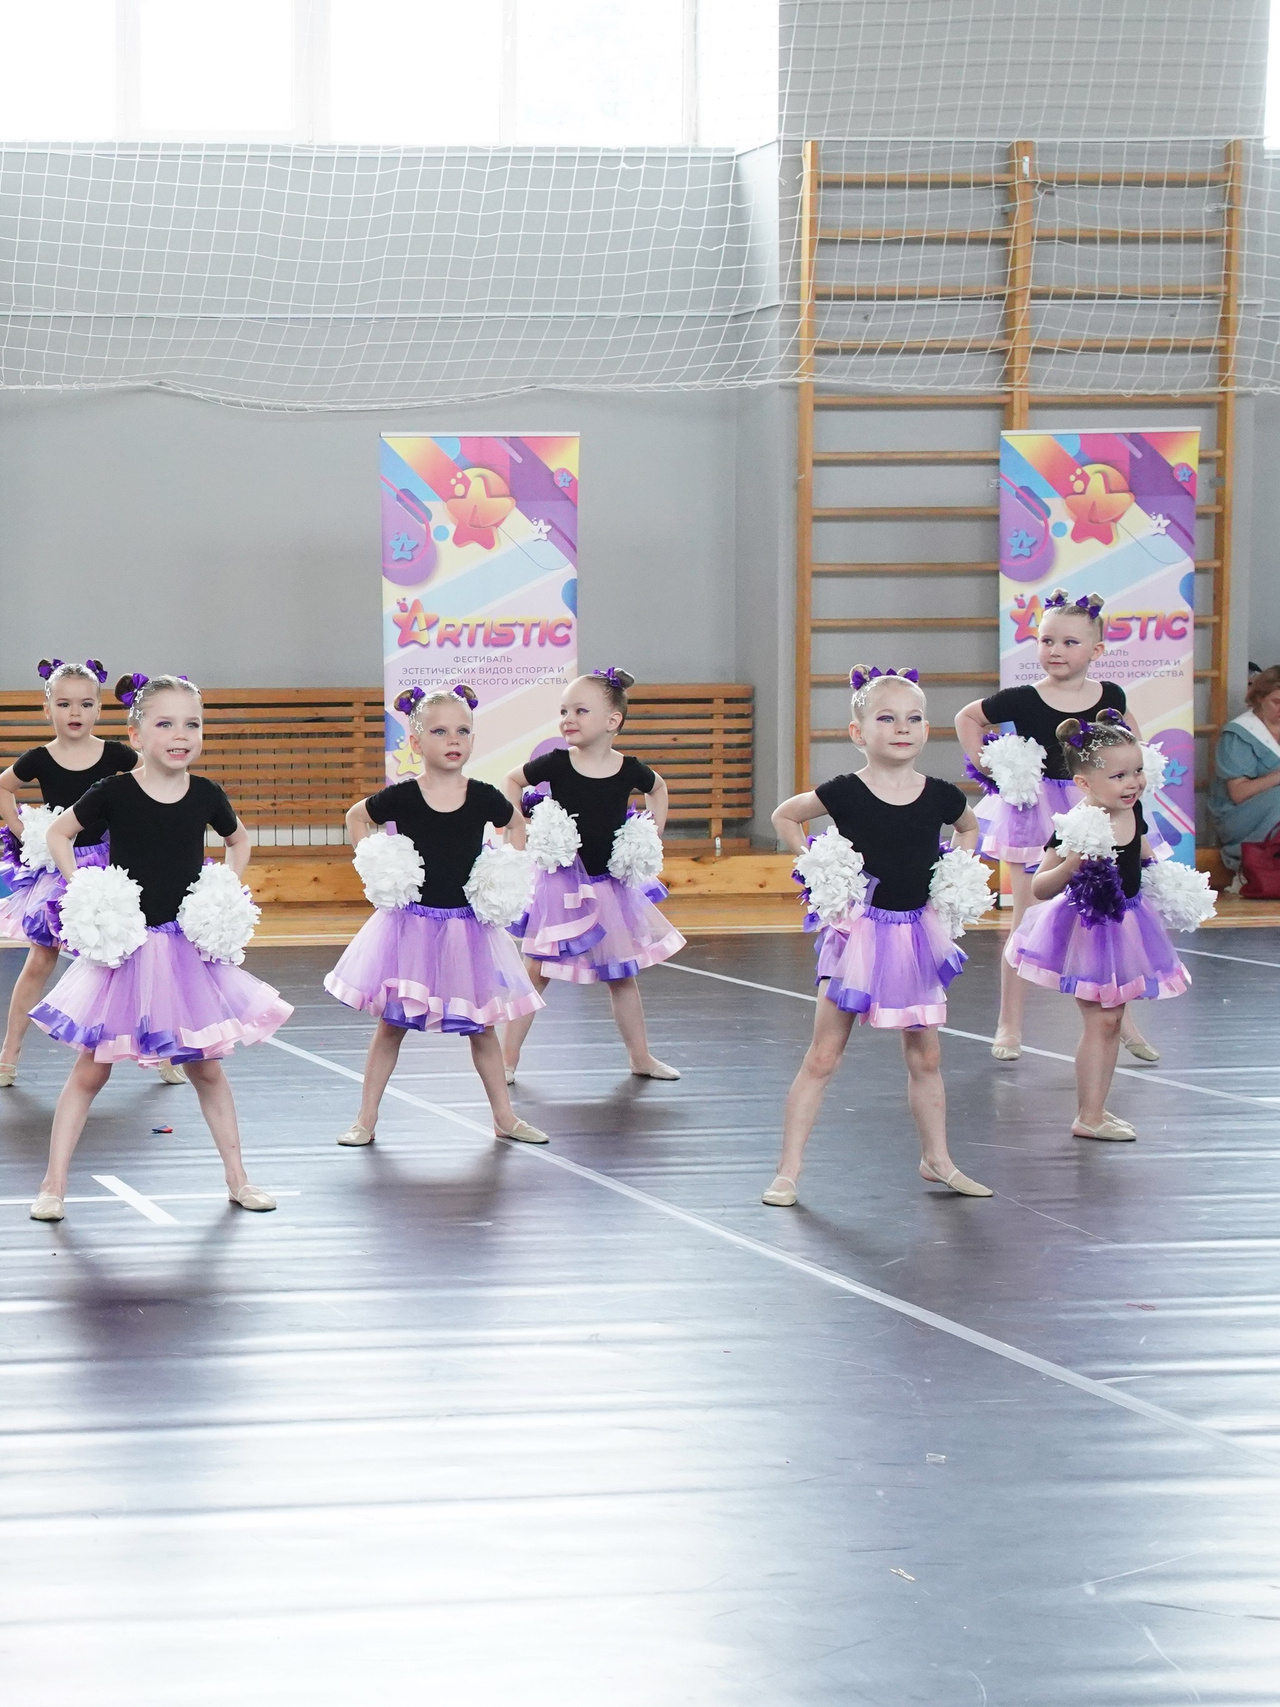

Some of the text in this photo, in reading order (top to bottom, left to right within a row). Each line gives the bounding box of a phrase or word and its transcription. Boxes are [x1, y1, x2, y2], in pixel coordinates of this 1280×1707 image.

[392, 598, 573, 648] ARTISTIC
[453, 655, 513, 664] ФЕСТИВАЛЬ
[1095, 660, 1130, 669] ВИДОВ
[1132, 659, 1171, 668] СПОРТА
[1174, 659, 1181, 667] И
[402, 666, 564, 676] ЭСТЕТИЧЕСКИХ ВИДОВ СПОРТА И
[1128, 670, 1184, 679] ИСКУССТВА
[398, 677, 569, 687] ХОРЕОГРАФИЧЕСКОГО ИСКУССТВА
